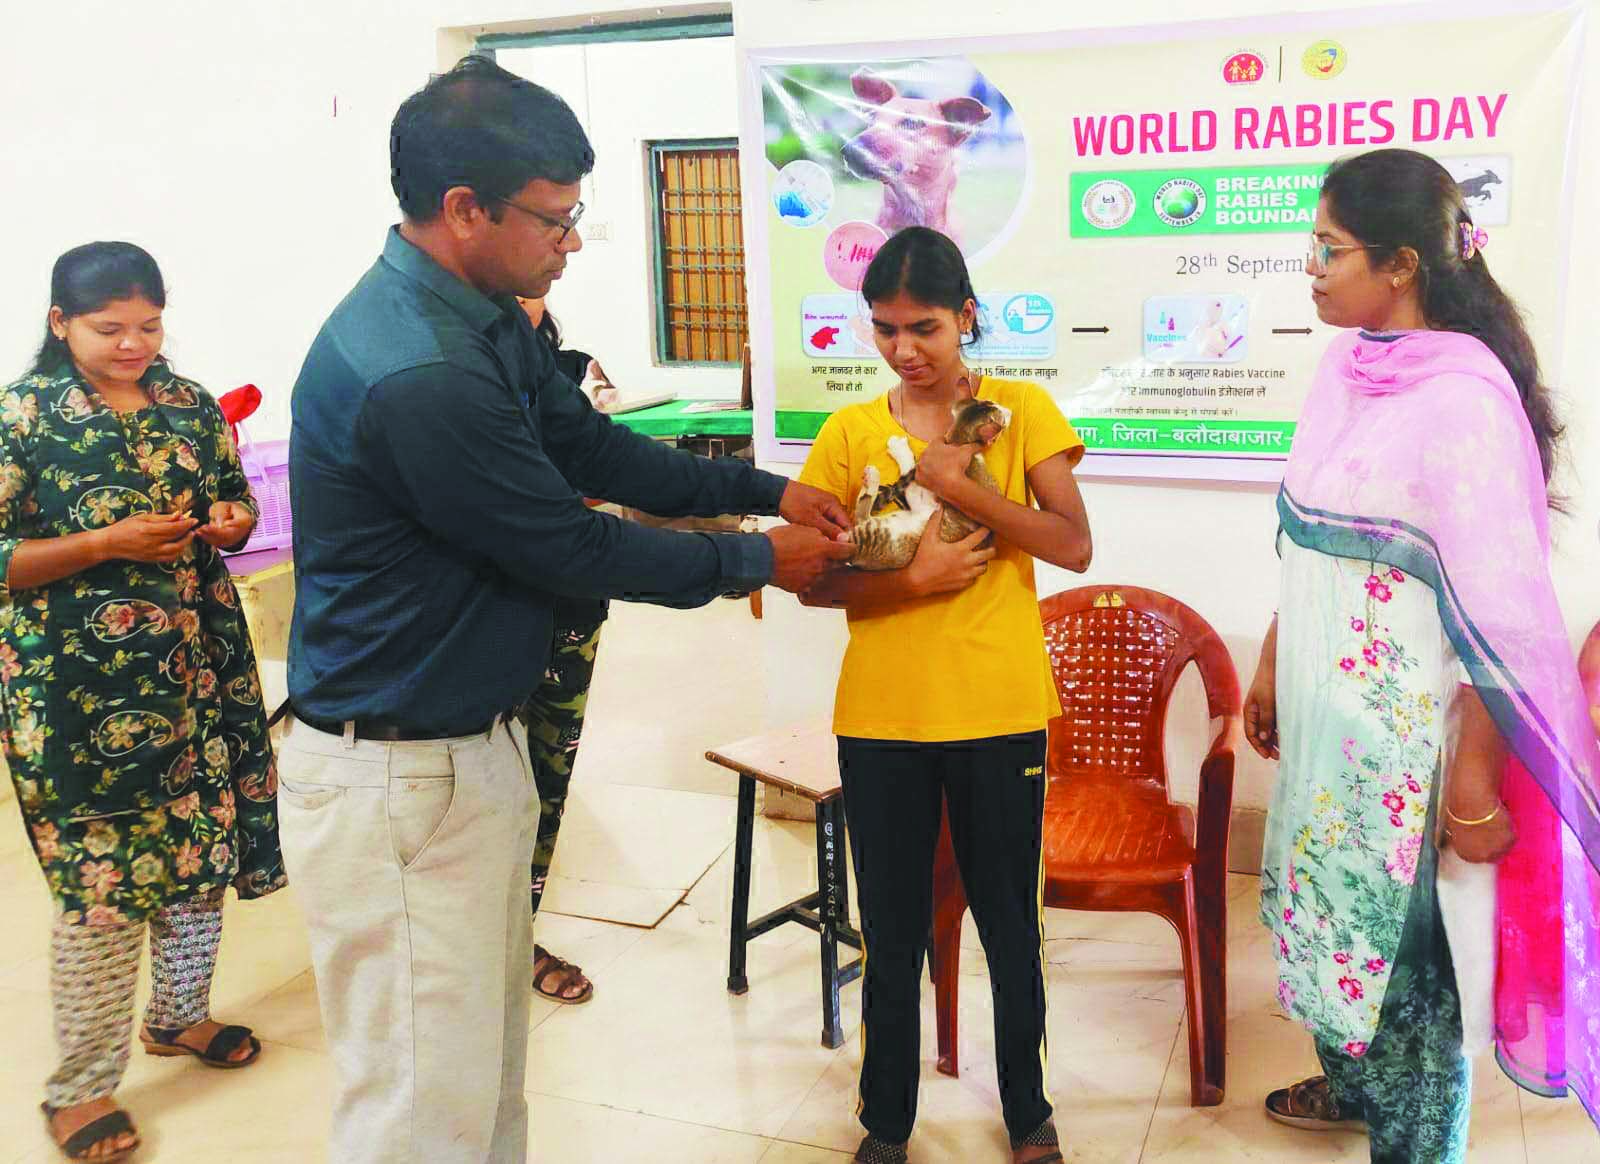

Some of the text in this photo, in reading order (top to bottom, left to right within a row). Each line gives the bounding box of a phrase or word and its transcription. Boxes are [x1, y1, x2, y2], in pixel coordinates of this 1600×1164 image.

[1073, 94, 1508, 156] WORLD RABIES DAY
[1215, 192, 1298, 209] RABIES
[1176, 253, 1217, 275] 28th
[985, 367, 993, 377] 15
[1212, 367, 1245, 379] Rabies
[1247, 367, 1286, 379] Vaccine
